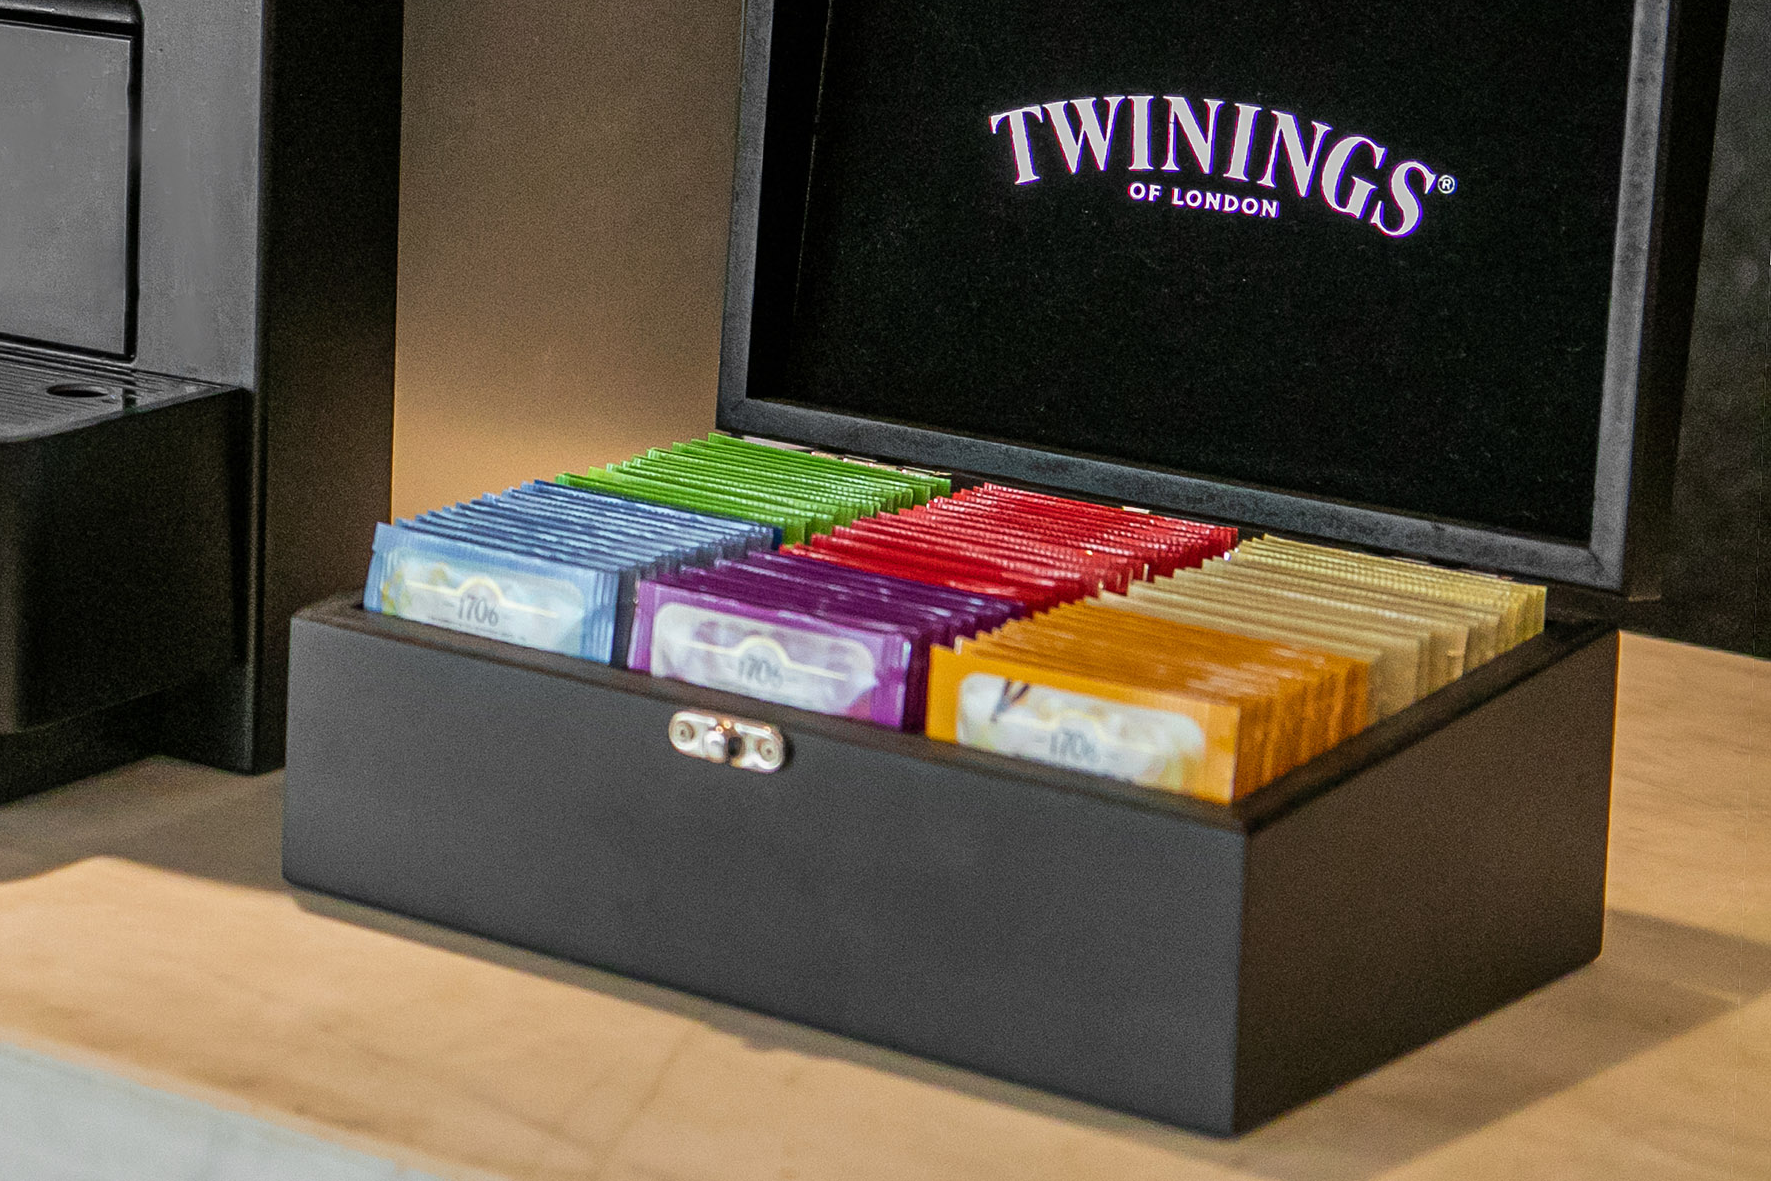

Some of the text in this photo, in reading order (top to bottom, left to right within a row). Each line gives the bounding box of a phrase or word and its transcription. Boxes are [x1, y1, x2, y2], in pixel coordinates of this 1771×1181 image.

[1128, 181, 1280, 219] OF LONDON
[458, 595, 499, 627] 1706
